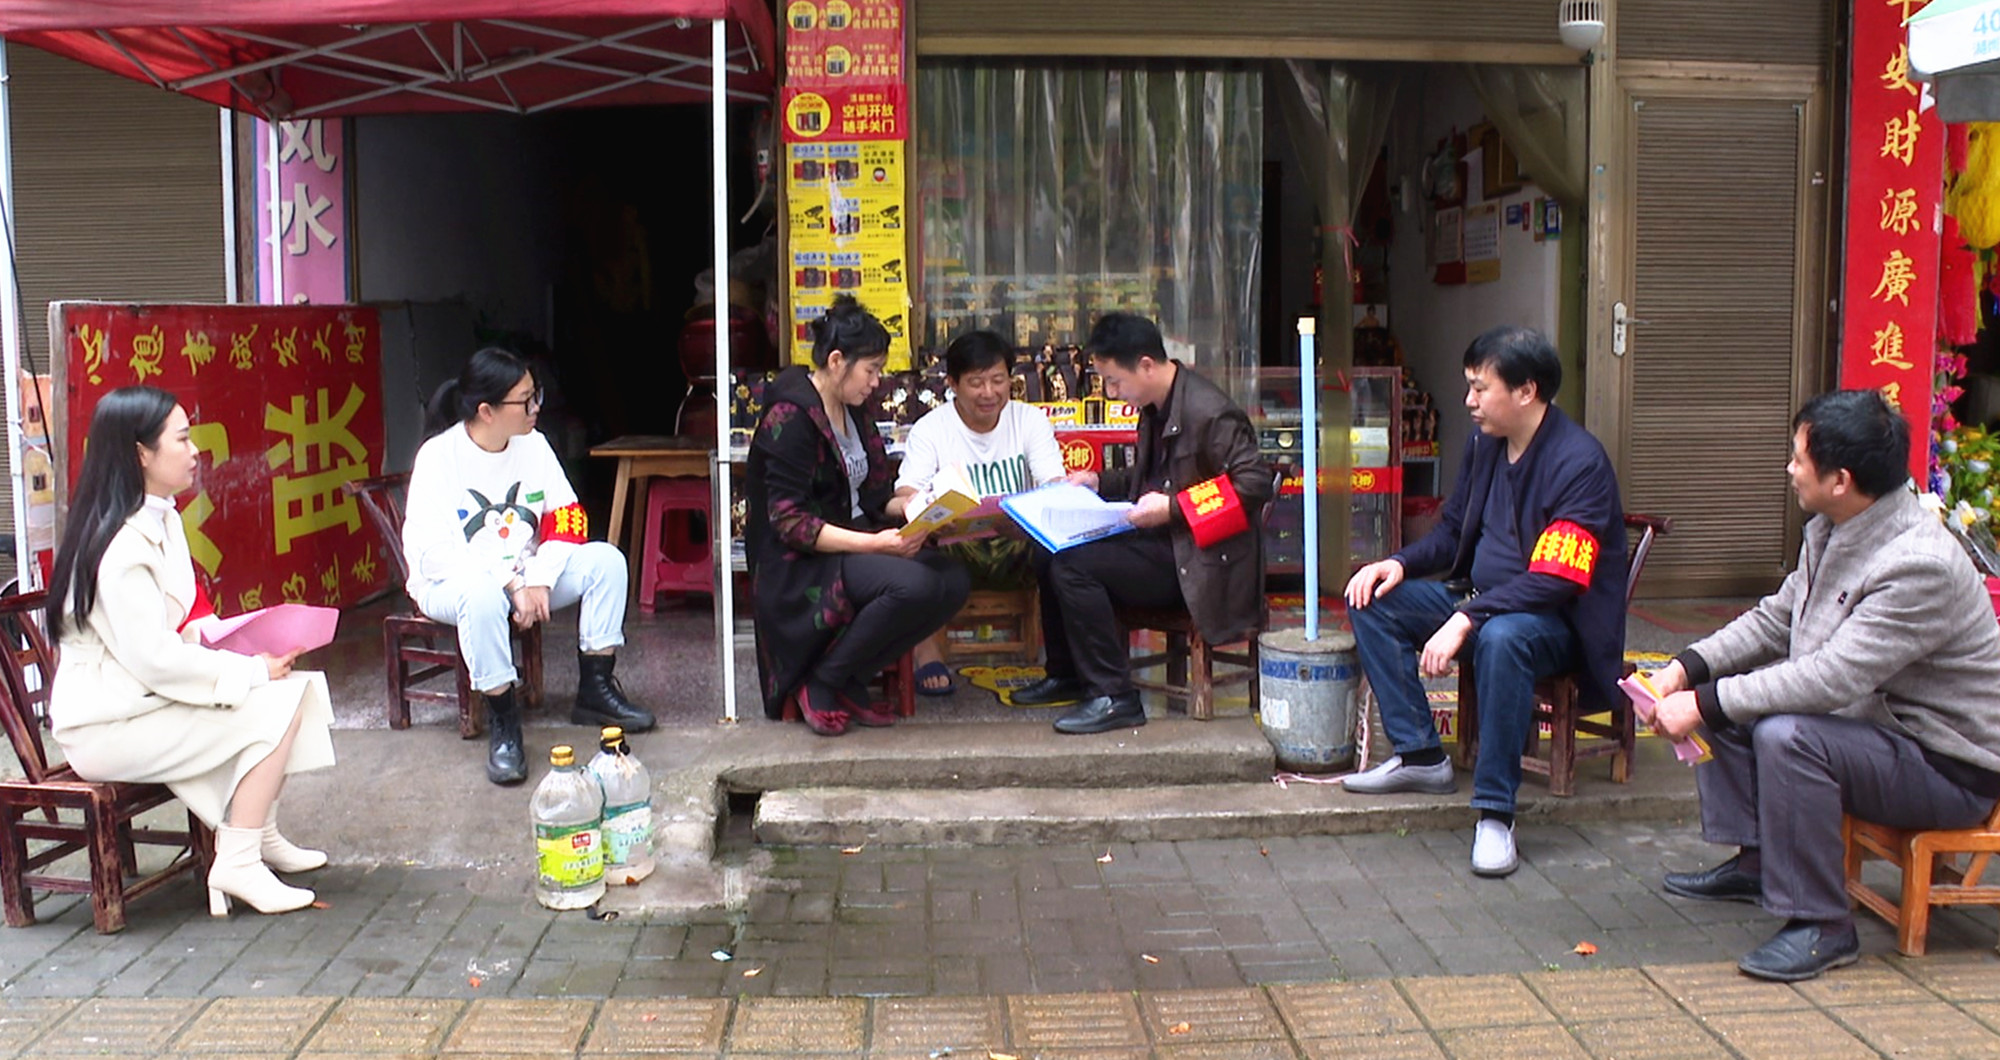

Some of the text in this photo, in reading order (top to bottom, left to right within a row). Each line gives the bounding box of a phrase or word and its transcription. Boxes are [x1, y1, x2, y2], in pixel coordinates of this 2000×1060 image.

[842, 104, 894, 118] 空调开放
[843, 119, 895, 134] 随手关门
[265, 119, 336, 305] 风水
[1870, 0, 1928, 412] 安財源廣進
[80, 323, 366, 385] 心想事成发大财
[554, 506, 588, 537] 禁非
